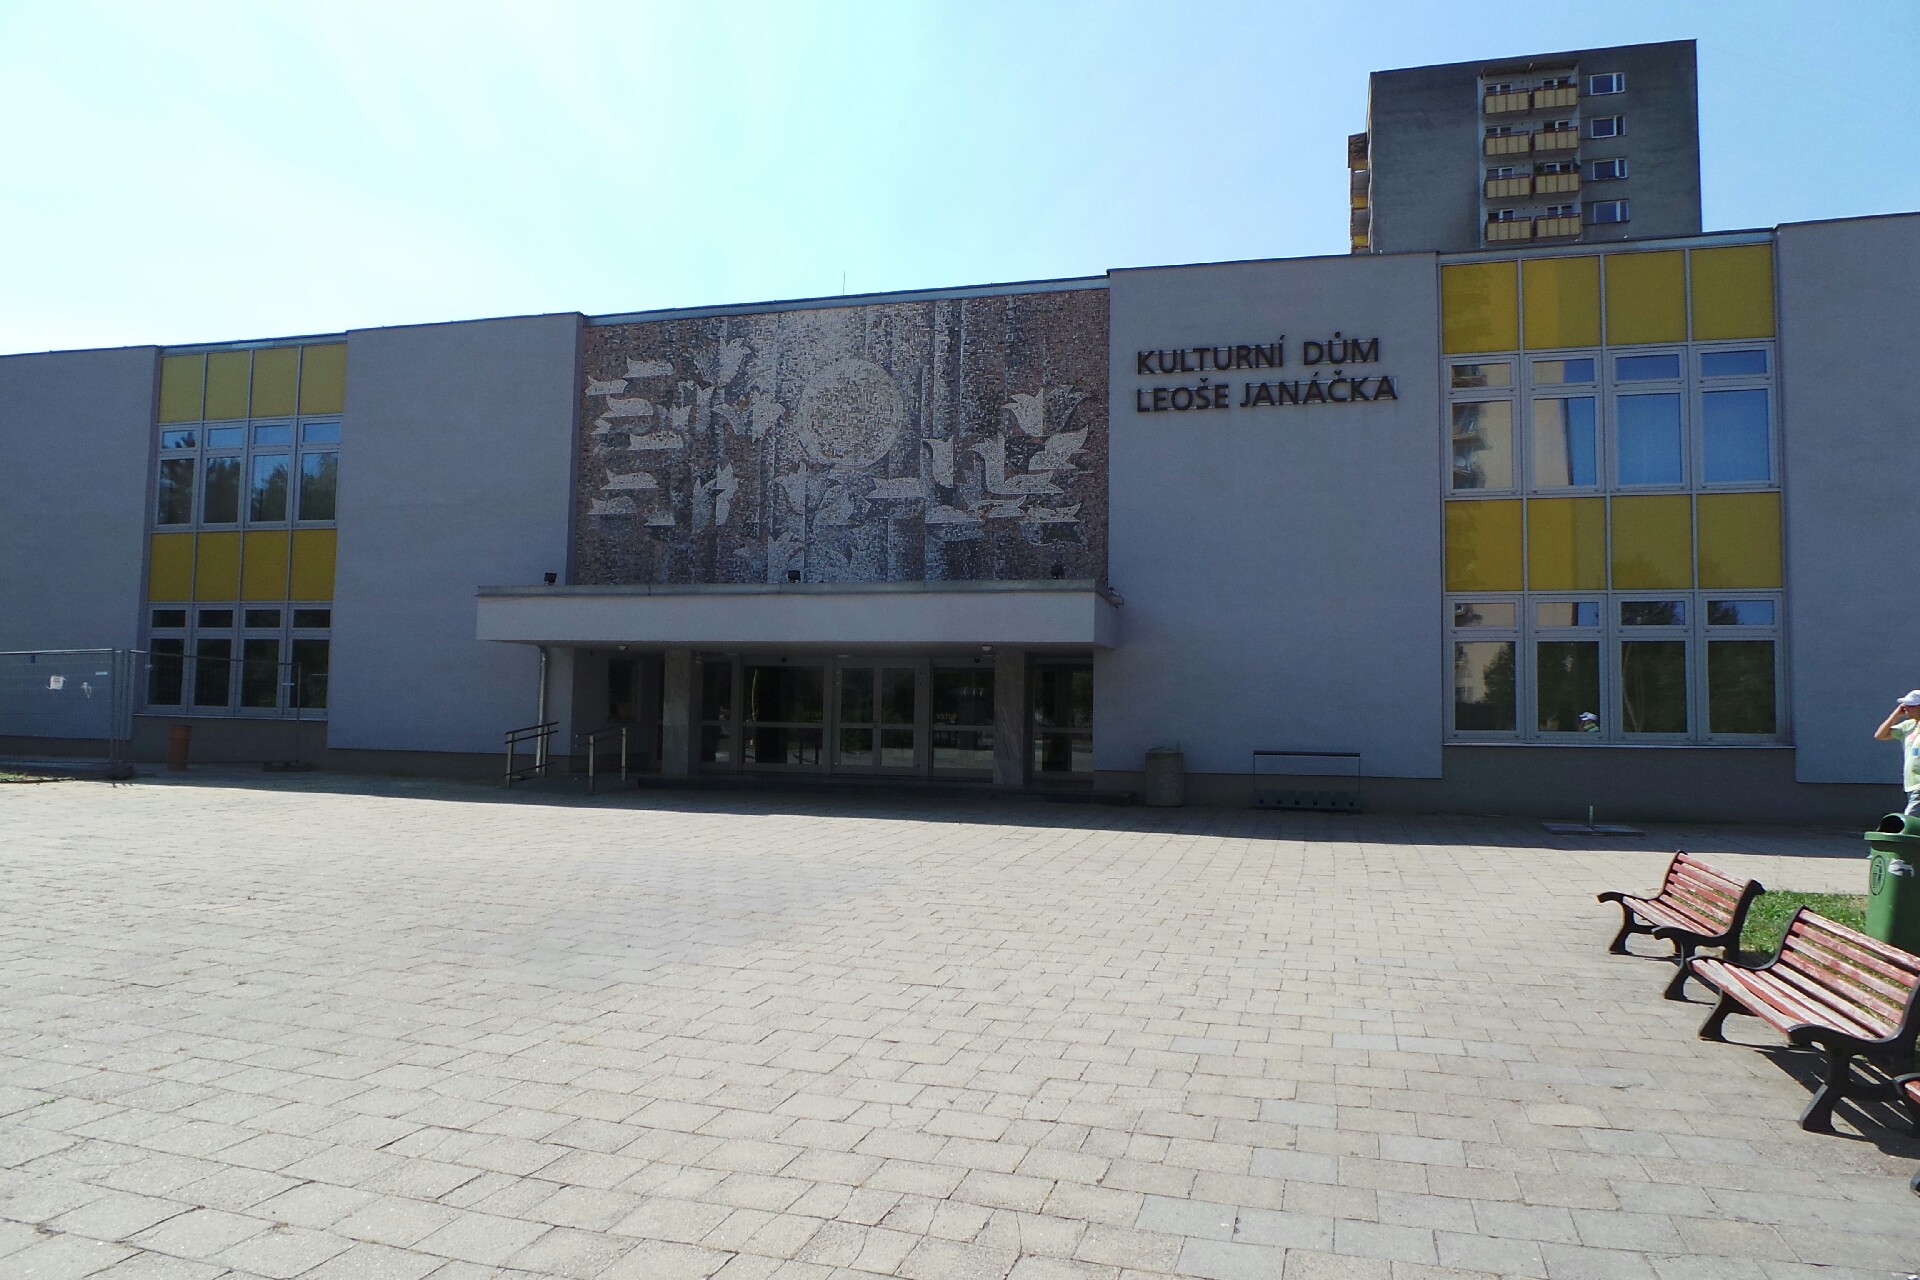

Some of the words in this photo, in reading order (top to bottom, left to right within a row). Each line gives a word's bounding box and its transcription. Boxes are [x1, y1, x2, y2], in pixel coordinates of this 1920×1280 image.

[1137, 334, 1285, 374] KULTURNÍ
[1303, 331, 1379, 365] DŮM
[1137, 377, 1229, 412] LEOŠE
[1240, 370, 1397, 407] JANÁČKA
